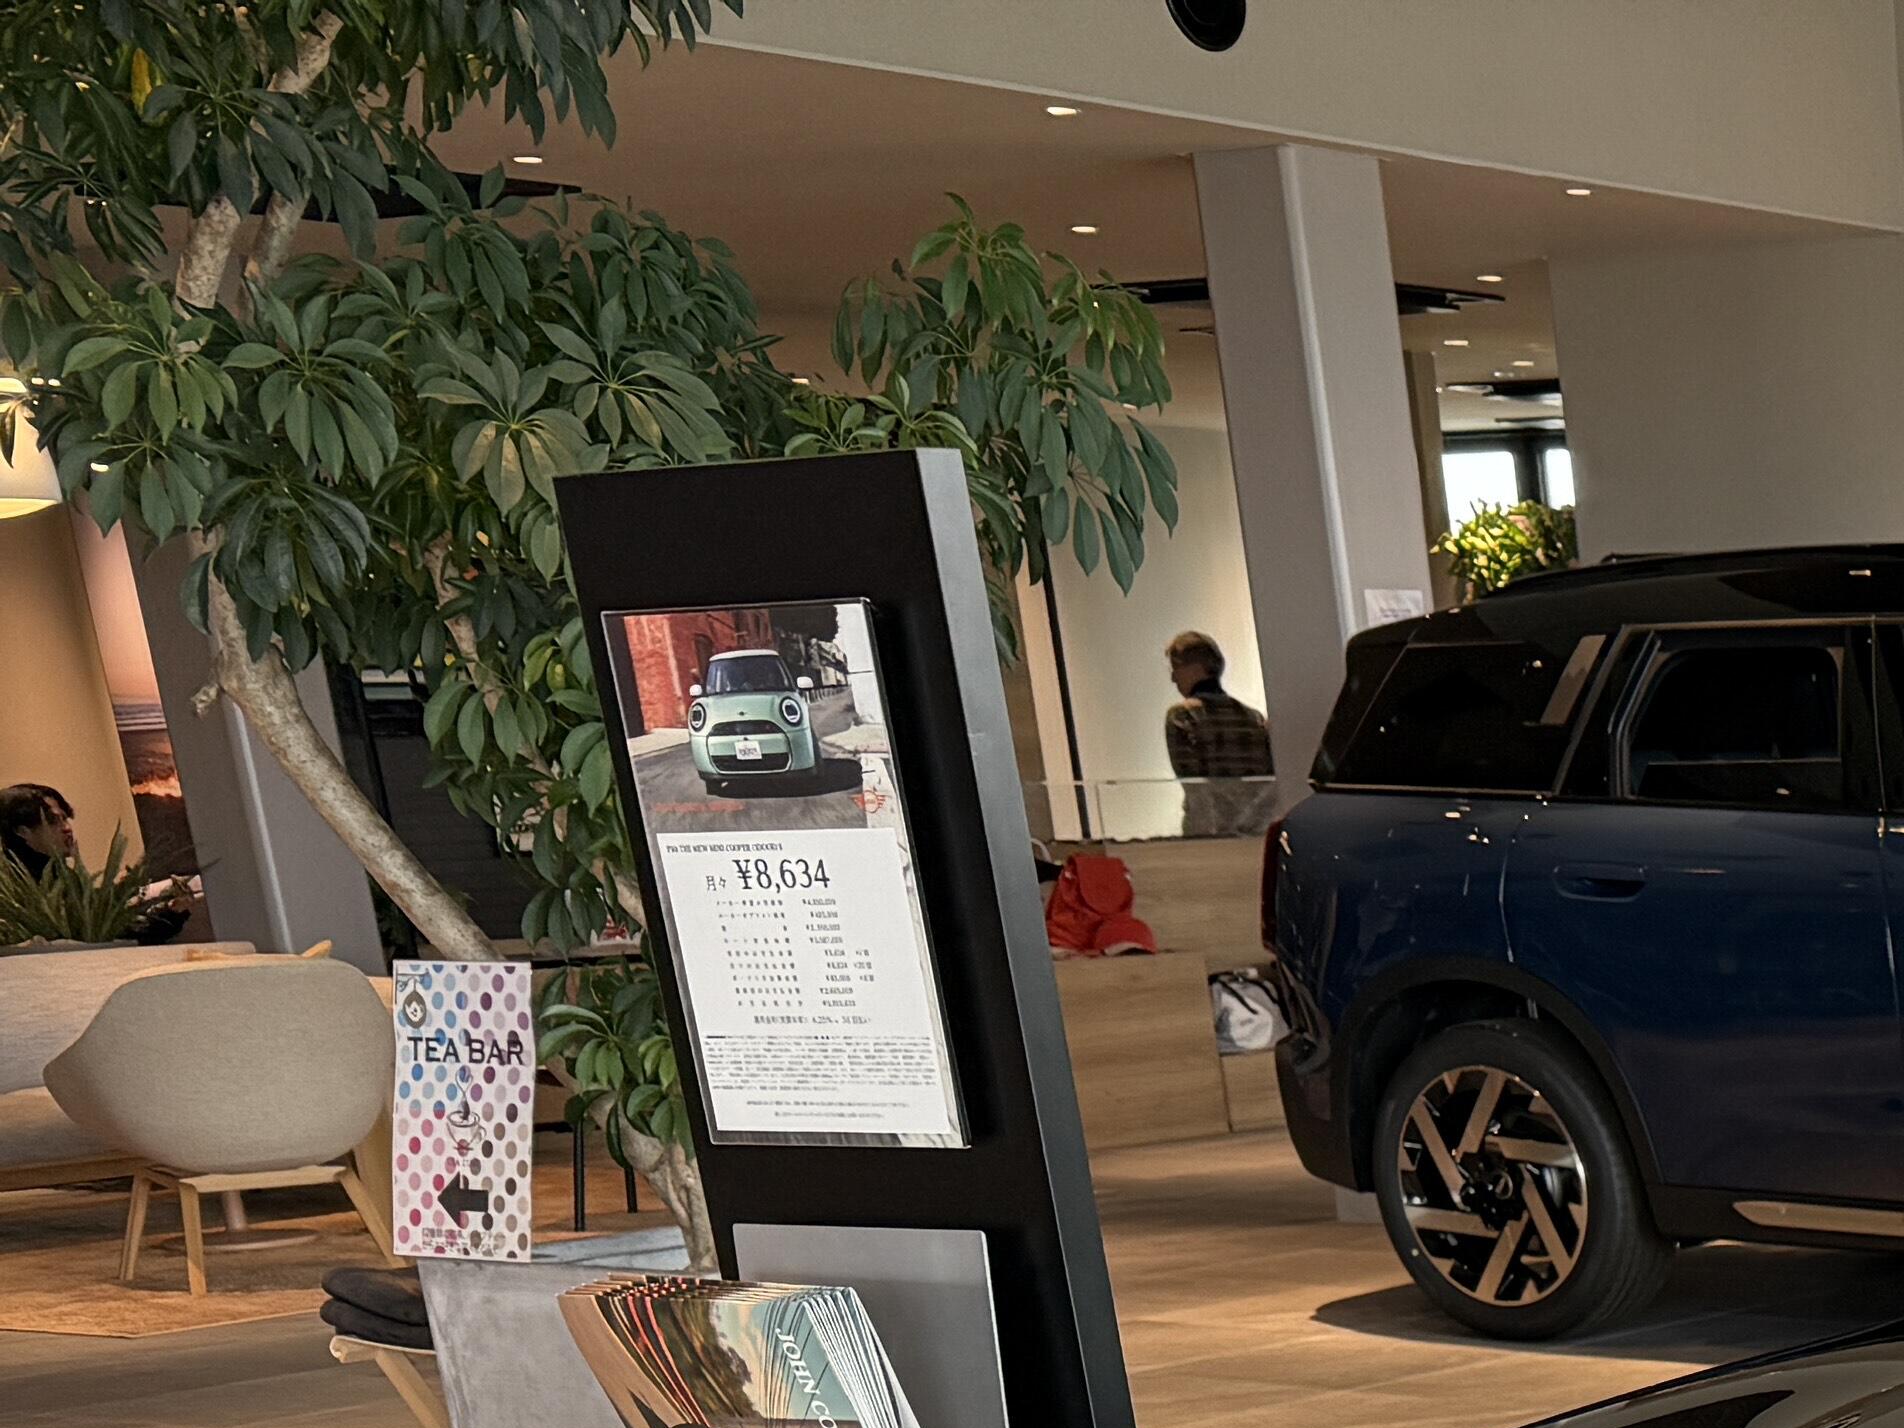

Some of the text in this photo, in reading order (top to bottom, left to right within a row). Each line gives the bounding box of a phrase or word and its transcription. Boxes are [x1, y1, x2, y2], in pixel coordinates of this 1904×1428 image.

[732, 858, 831, 894] ¥8,634
[407, 1036, 524, 1066] TEA BAR
[775, 1327, 821, 1396] JOHN
